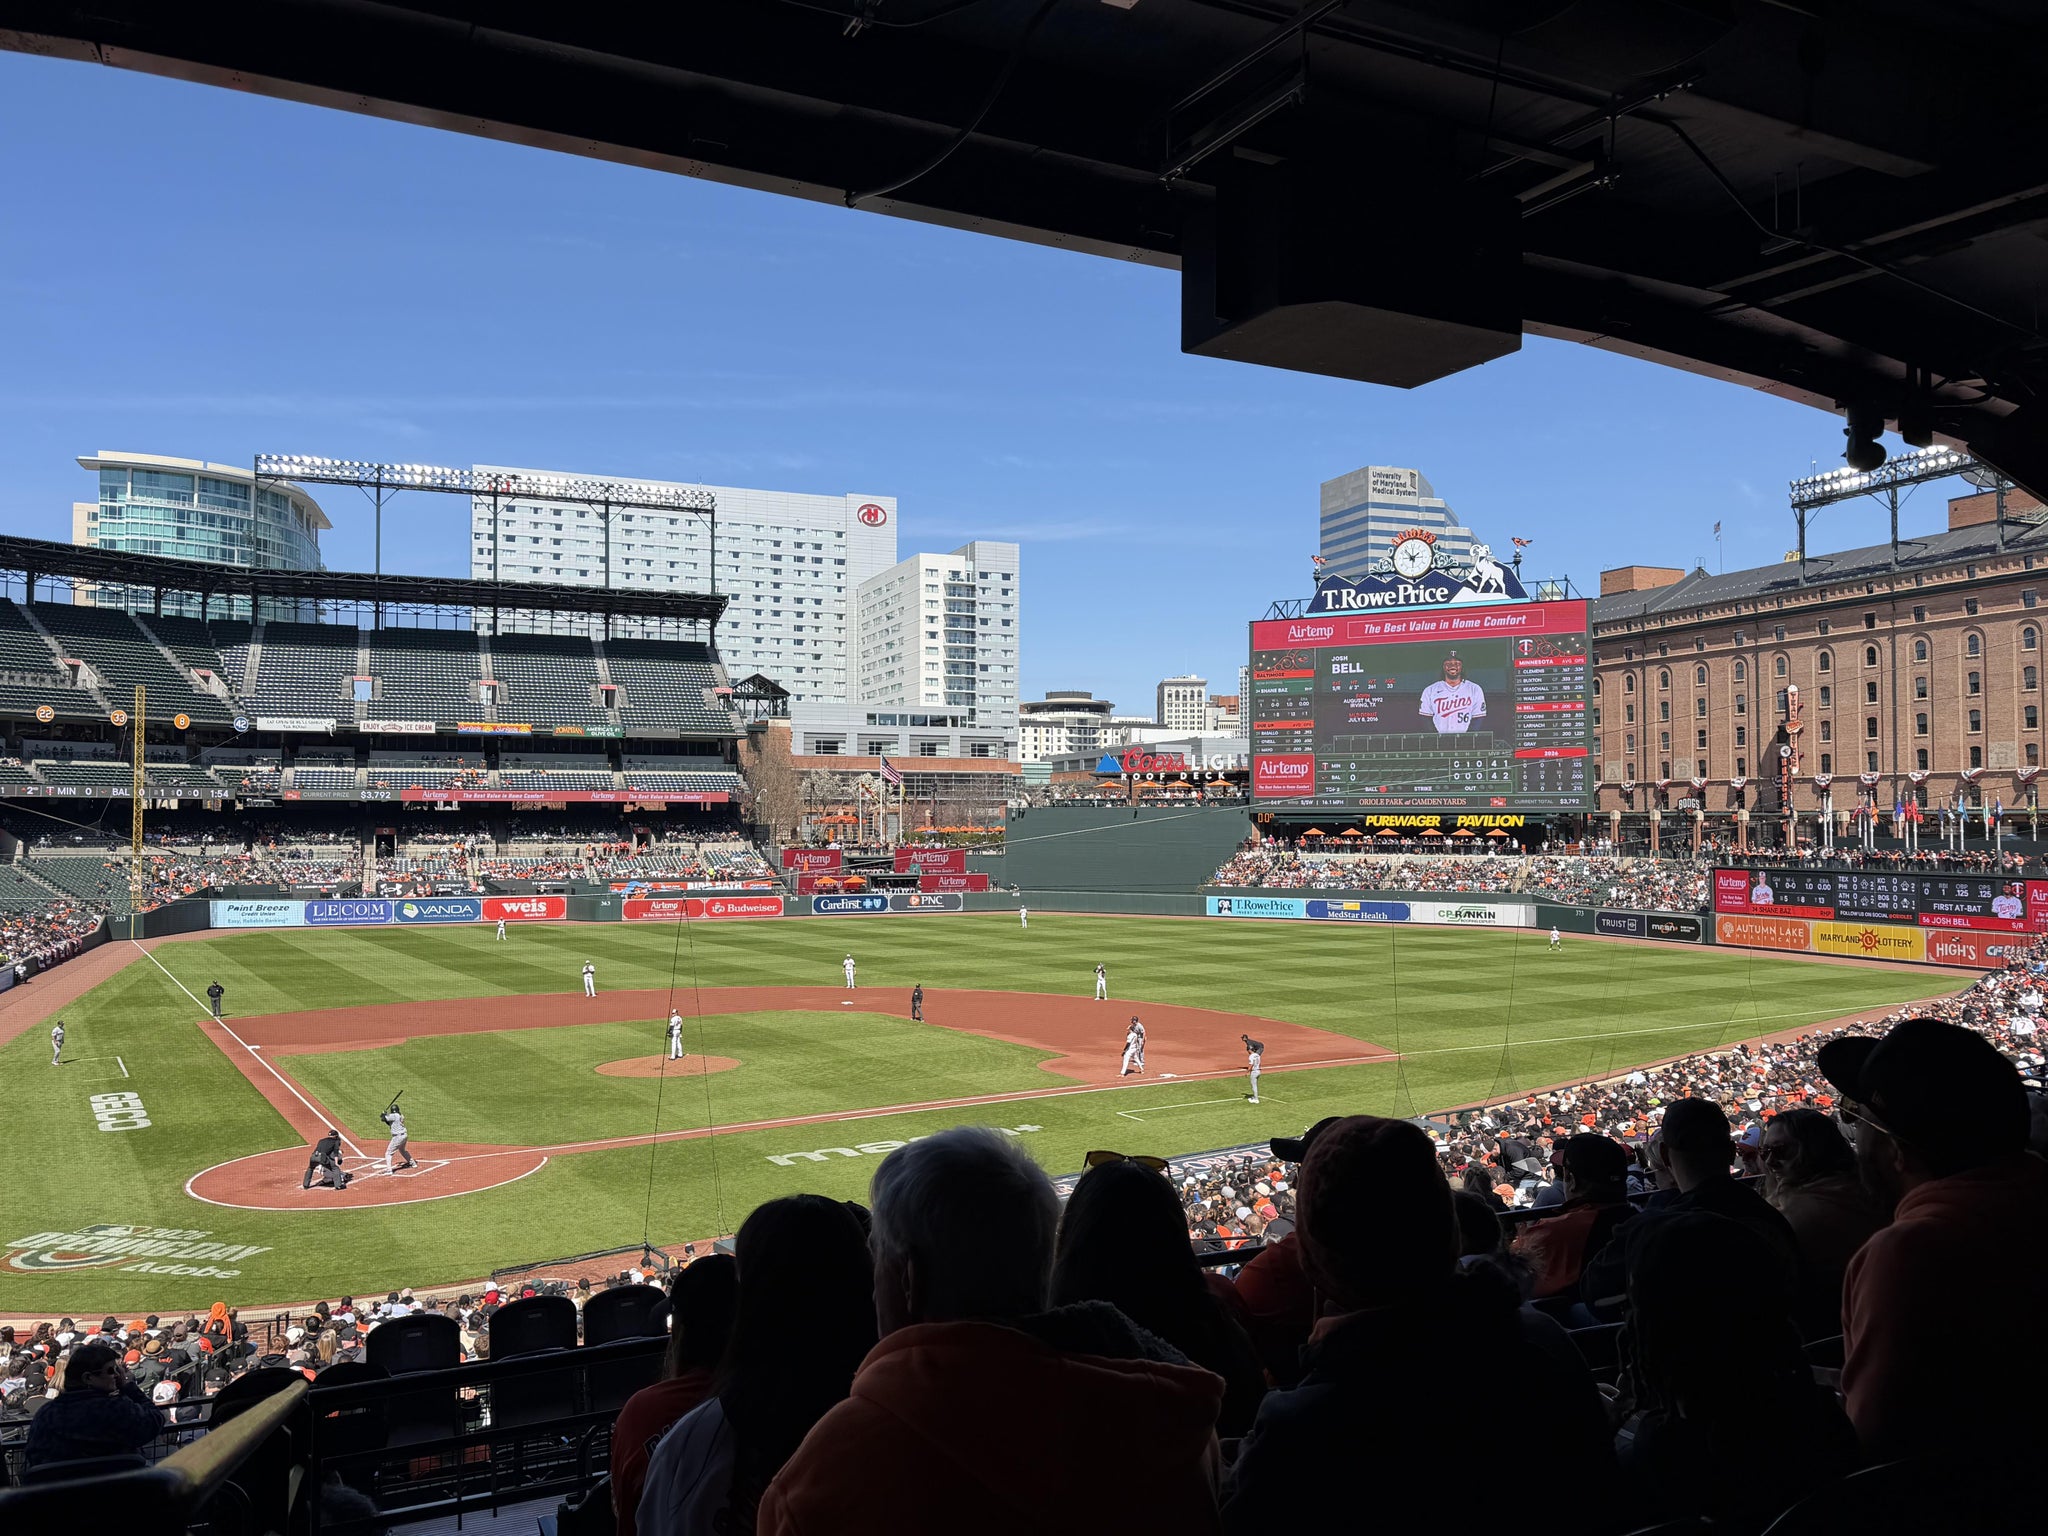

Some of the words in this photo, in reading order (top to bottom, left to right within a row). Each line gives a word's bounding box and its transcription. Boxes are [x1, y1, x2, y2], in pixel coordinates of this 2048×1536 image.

[1372, 471, 1401, 480] University
[1380, 480, 1406, 488] Maryland
[1372, 487, 1394, 495] Medical
[1396, 488, 1416, 496] System
[1392, 528, 1438, 546] ORIOLES
[1364, 624, 1382, 634] The
[1384, 622, 1406, 634] Best
[1409, 621, 1436, 632] Value
[1439, 619, 1448, 630] in
[1452, 617, 1480, 628] Home
[1484, 615, 1527, 626] Comfort
[1288, 625, 1334, 640] Airtemp
[1332, 662, 1364, 674] BELL
[1434, 695, 1472, 714] Twins
[39, 710, 52, 718] 22
[114, 714, 125, 722] 33
[1458, 712, 1470, 724] 56
[235, 720, 246, 728] 42
[1122, 746, 1187, 772] Coors
[1259, 760, 1309, 777] Airtemp
[1120, 772, 1166, 780] ROOF
[1180, 772, 1225, 780] DECK
[57, 788, 76, 796] MIN
[112, 788, 130, 796] BAL
[192, 789, 200, 797] 0
[210, 790, 229, 798] 1:54
[360, 791, 392, 800] $3,792
[422, 790, 448, 800] Airtemp
[591, 792, 616, 800] Airtemp
[1366, 815, 1440, 826] PUREWAGER
[1456, 815, 1525, 827] PAVILION
[794, 852, 832, 866] Airtemp
[911, 852, 949, 865] Airtemp
[938, 876, 967, 888] Airtemp
[1719, 876, 1746, 888] Airtemp
[651, 901, 678, 911] Airtemp
[820, 900, 862, 912] CareFirst
[922, 896, 943, 905] PNC
[419, 904, 474, 914] VANDA
[501, 899, 548, 914] weis
[1933, 903, 1954, 911] FIRST
[1954, 904, 1982, 912] AT-BAT
[1328, 911, 1360, 919] MedStar
[1360, 912, 1388, 920] Health
[1602, 918, 1626, 928] TRUIST
[1952, 918, 1972, 926] BELL
[1736, 924, 1776, 935] AUTUMN
[1780, 926, 1804, 937] LAKE
[1736, 934, 1804, 945] HEALTHCARE
[1820, 934, 1860, 944] MARYLAND
[1936, 943, 1976, 960] HIGH'S
[90, 1092, 152, 1132] GEICO
[5, 1231, 194, 1257] OPENING
[168, 1242, 274, 1262] DAY
[119, 1262, 242, 1279] Adobe
